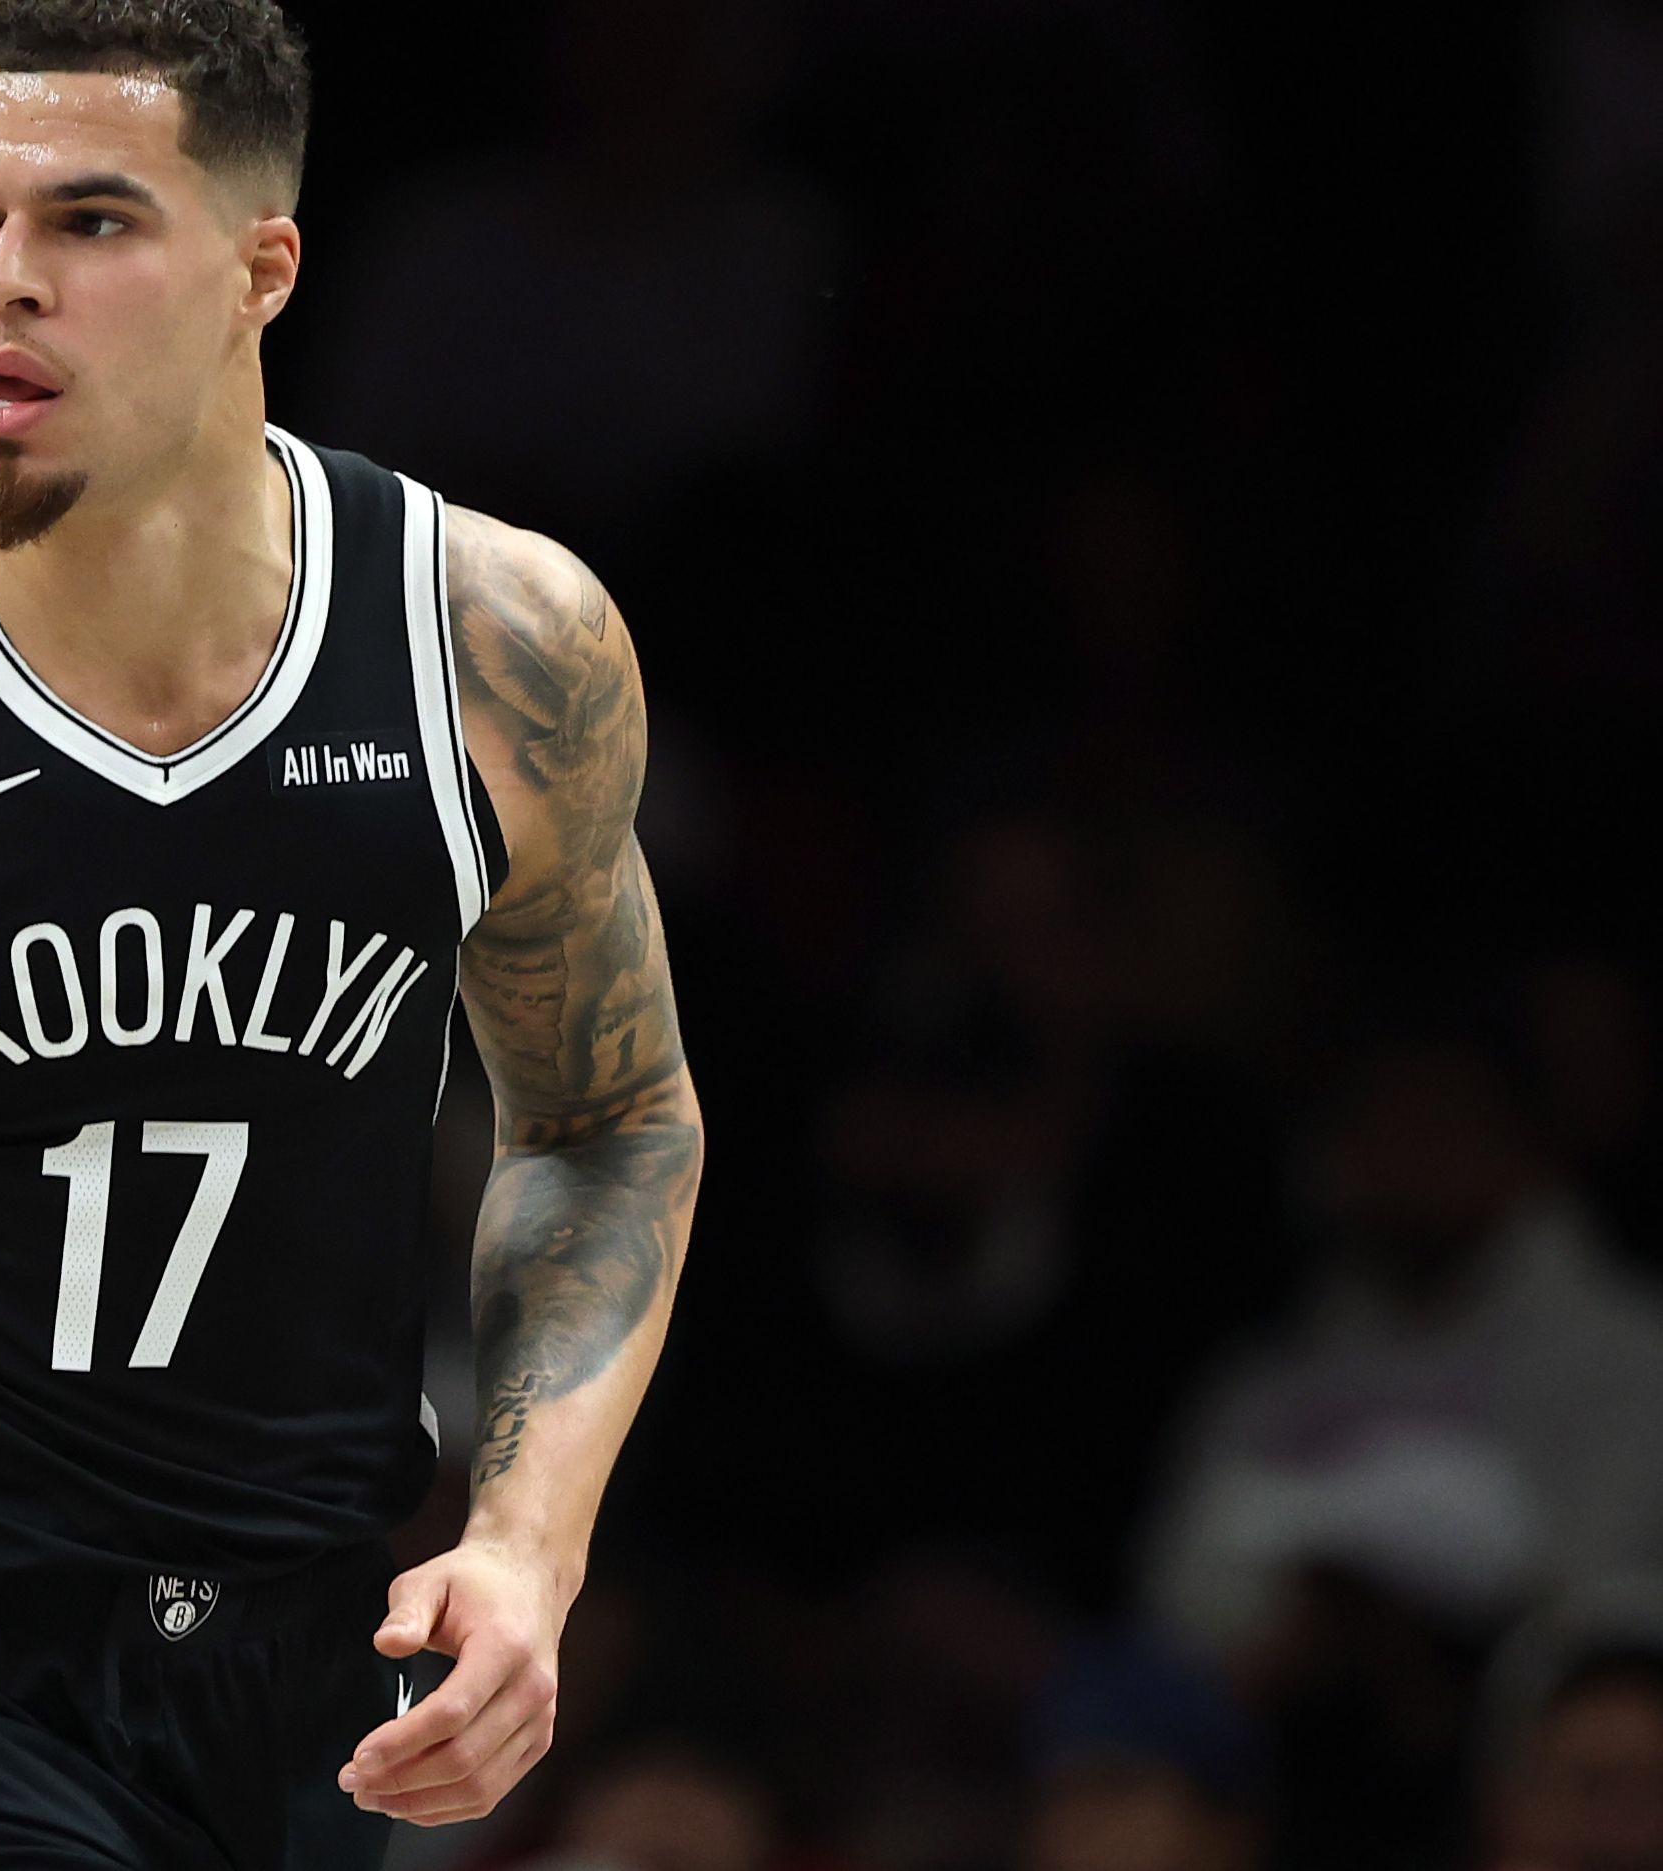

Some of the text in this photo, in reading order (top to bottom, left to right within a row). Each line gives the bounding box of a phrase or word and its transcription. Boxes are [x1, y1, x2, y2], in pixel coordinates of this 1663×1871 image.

[283, 741, 410, 787] All In Won
[41, 1120, 249, 1372] 17
[155, 1575, 213, 1603] NETS
